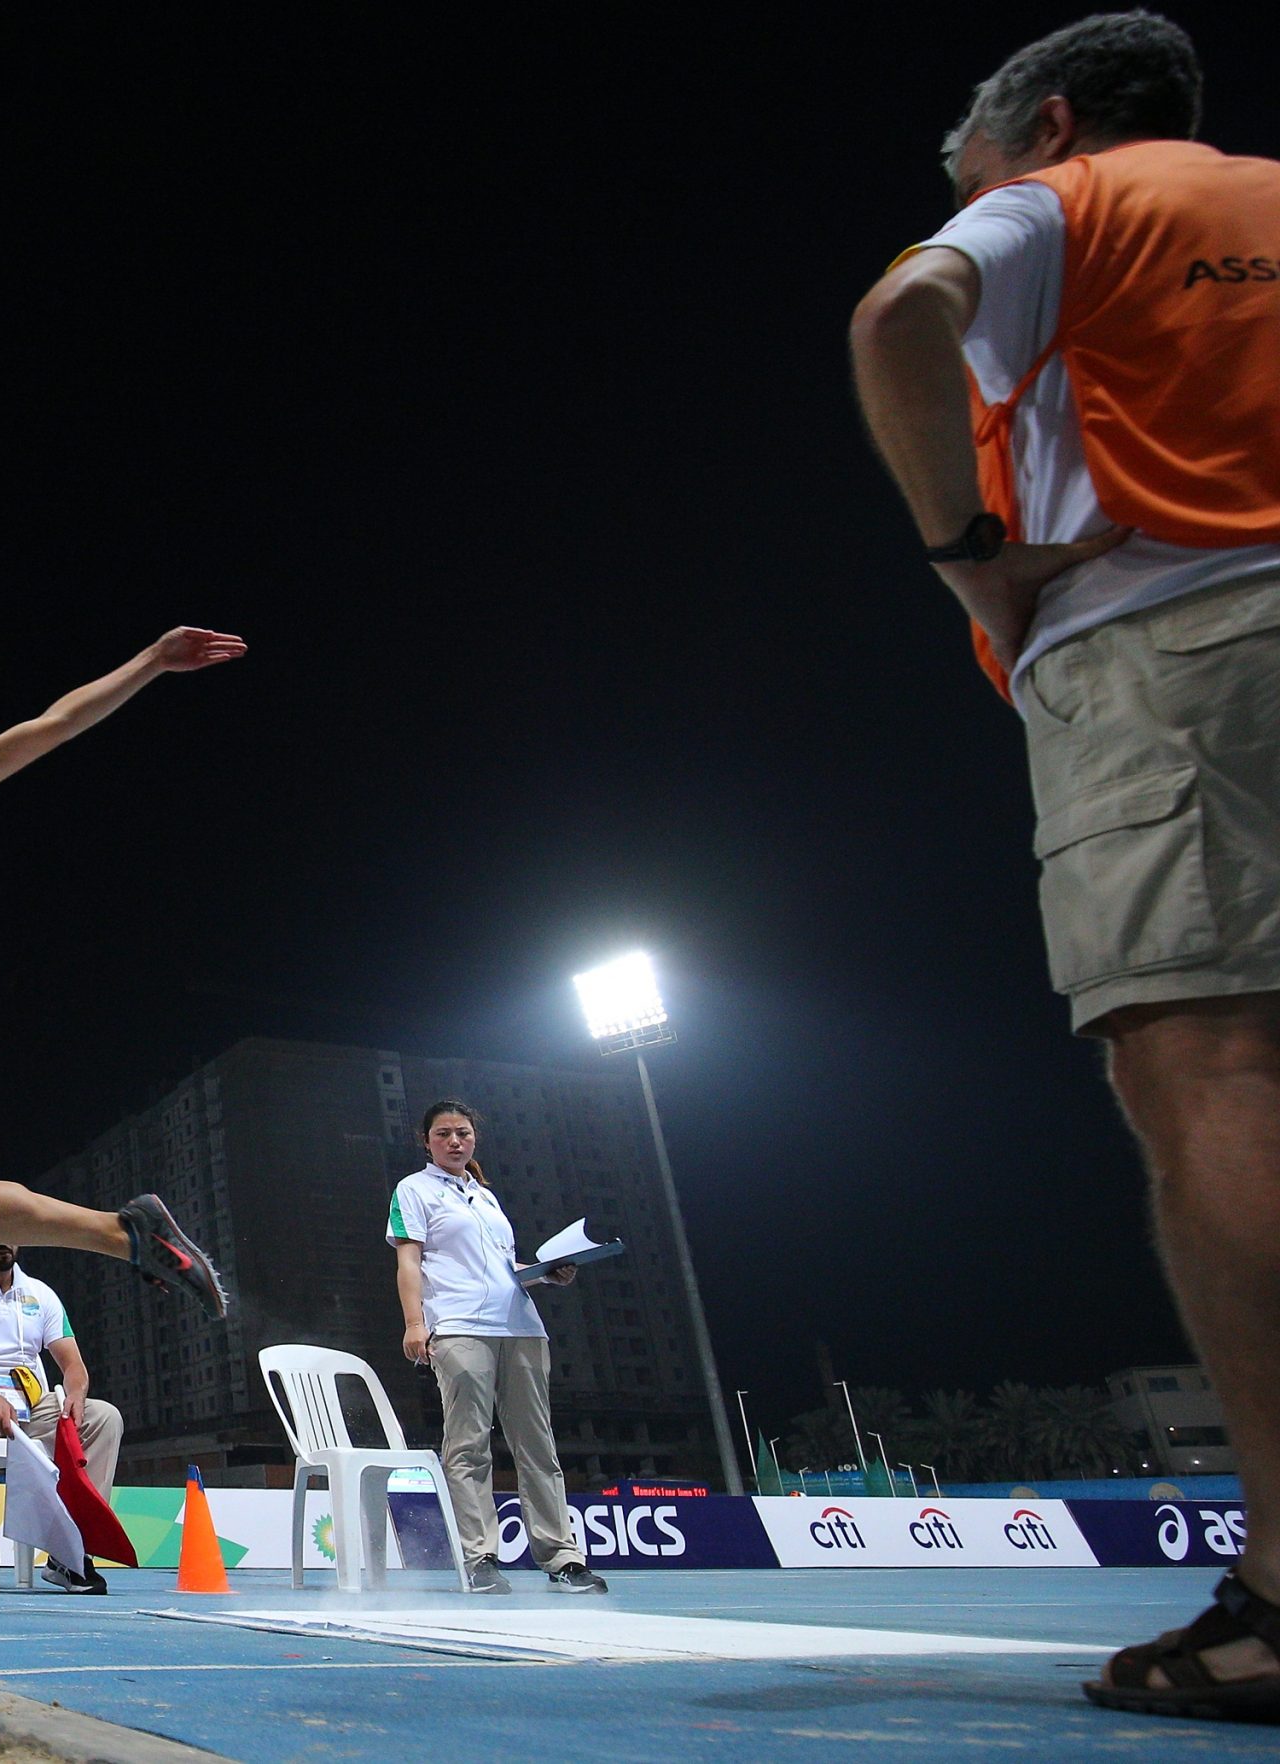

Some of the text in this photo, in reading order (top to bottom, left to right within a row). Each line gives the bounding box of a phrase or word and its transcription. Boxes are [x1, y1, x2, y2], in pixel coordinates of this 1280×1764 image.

[809, 1514, 867, 1549] citi
[909, 1515, 964, 1549] citi
[1003, 1517, 1057, 1550] citi
